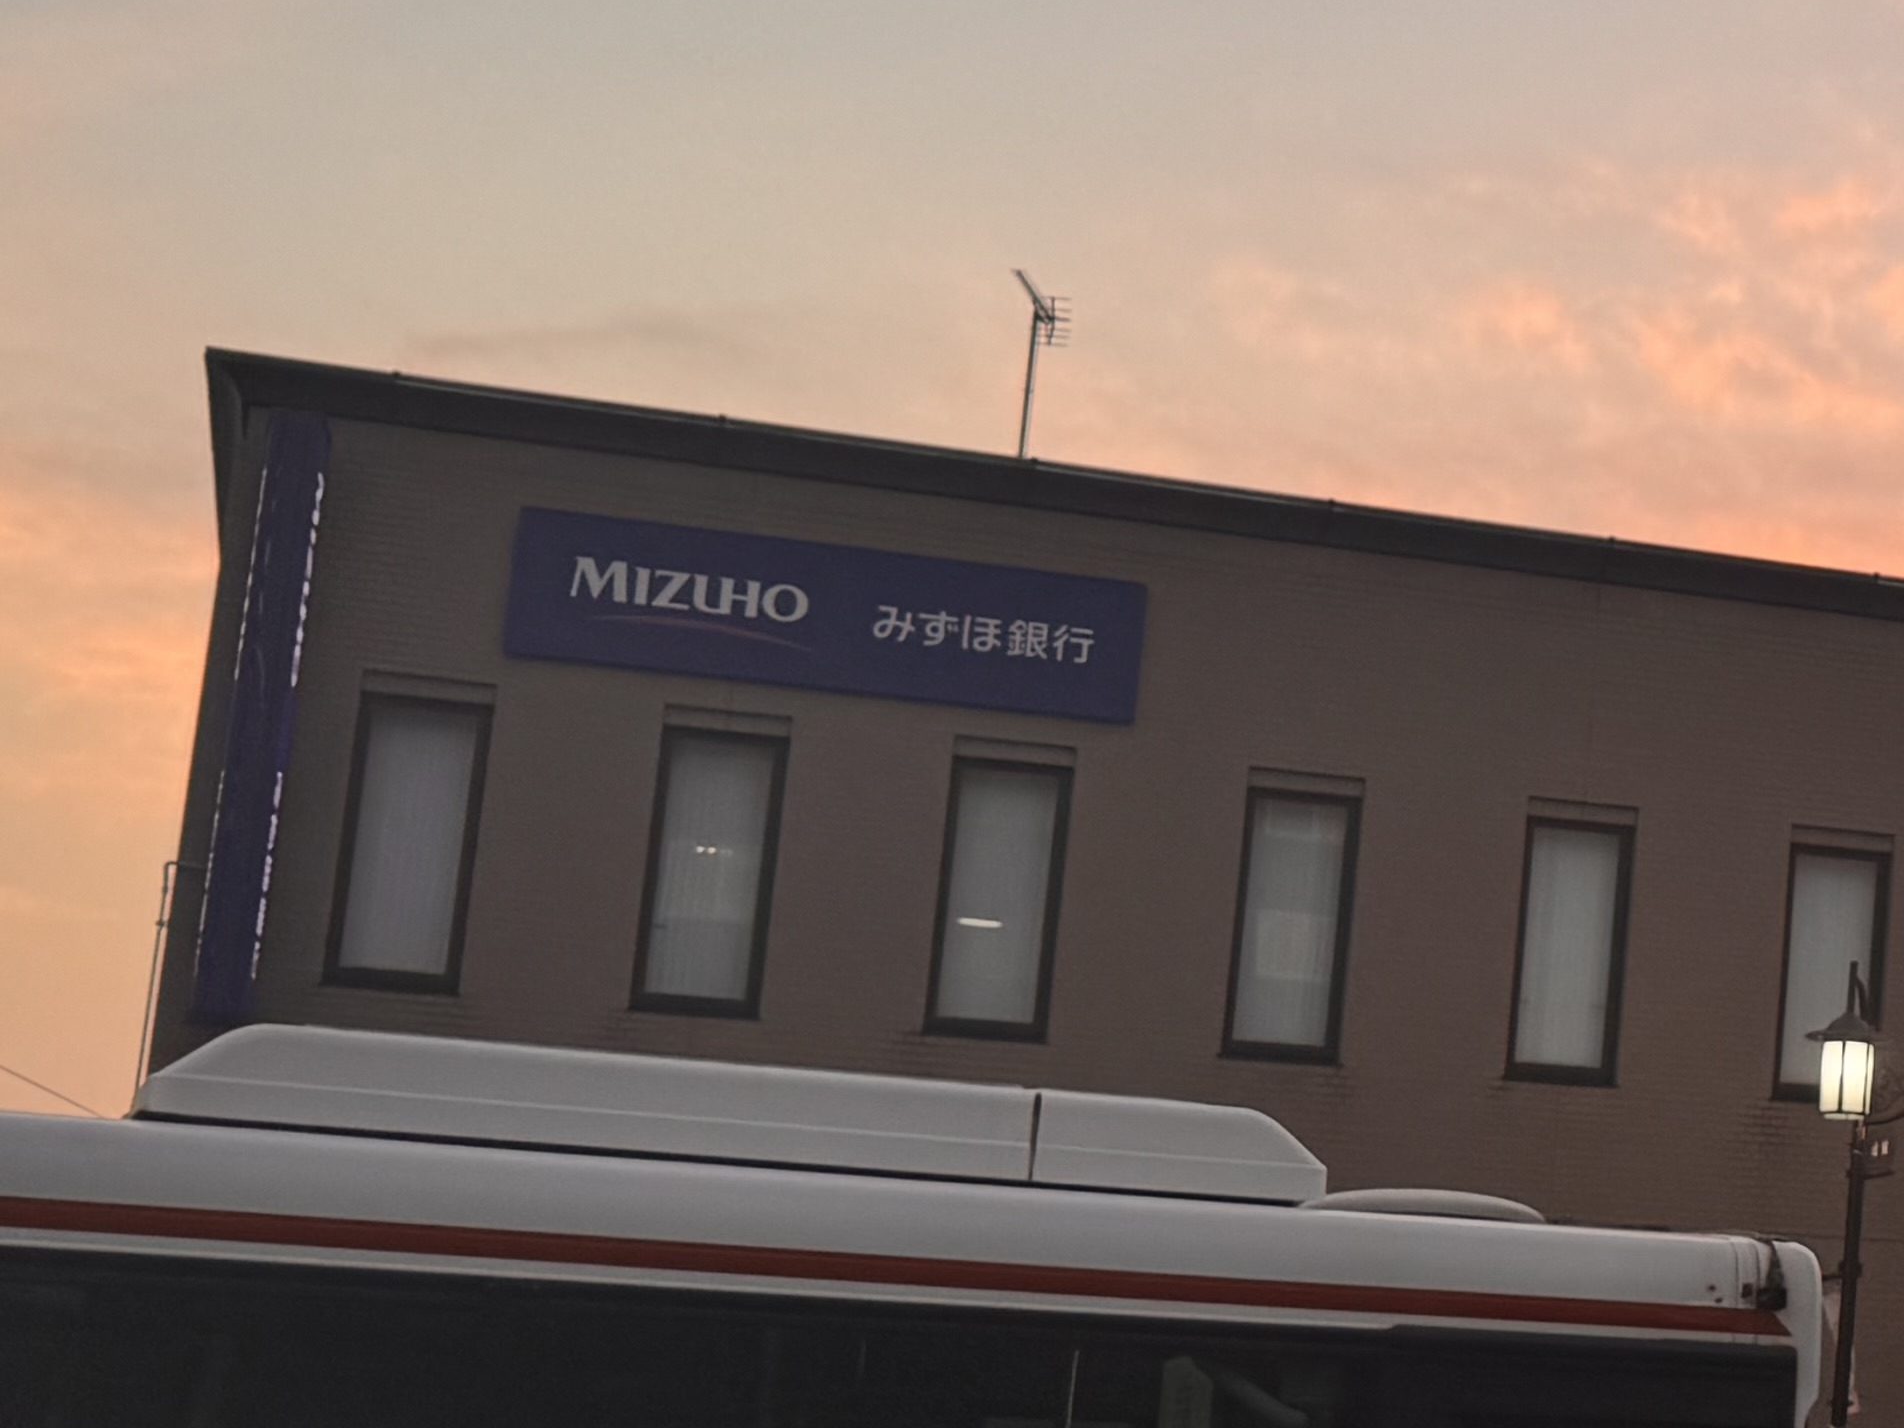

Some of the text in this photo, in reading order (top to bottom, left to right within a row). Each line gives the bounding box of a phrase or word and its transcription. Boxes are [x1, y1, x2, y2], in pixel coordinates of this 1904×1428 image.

[569, 556, 809, 623] MIZUHO
[872, 605, 1094, 663] みずほ銀行
